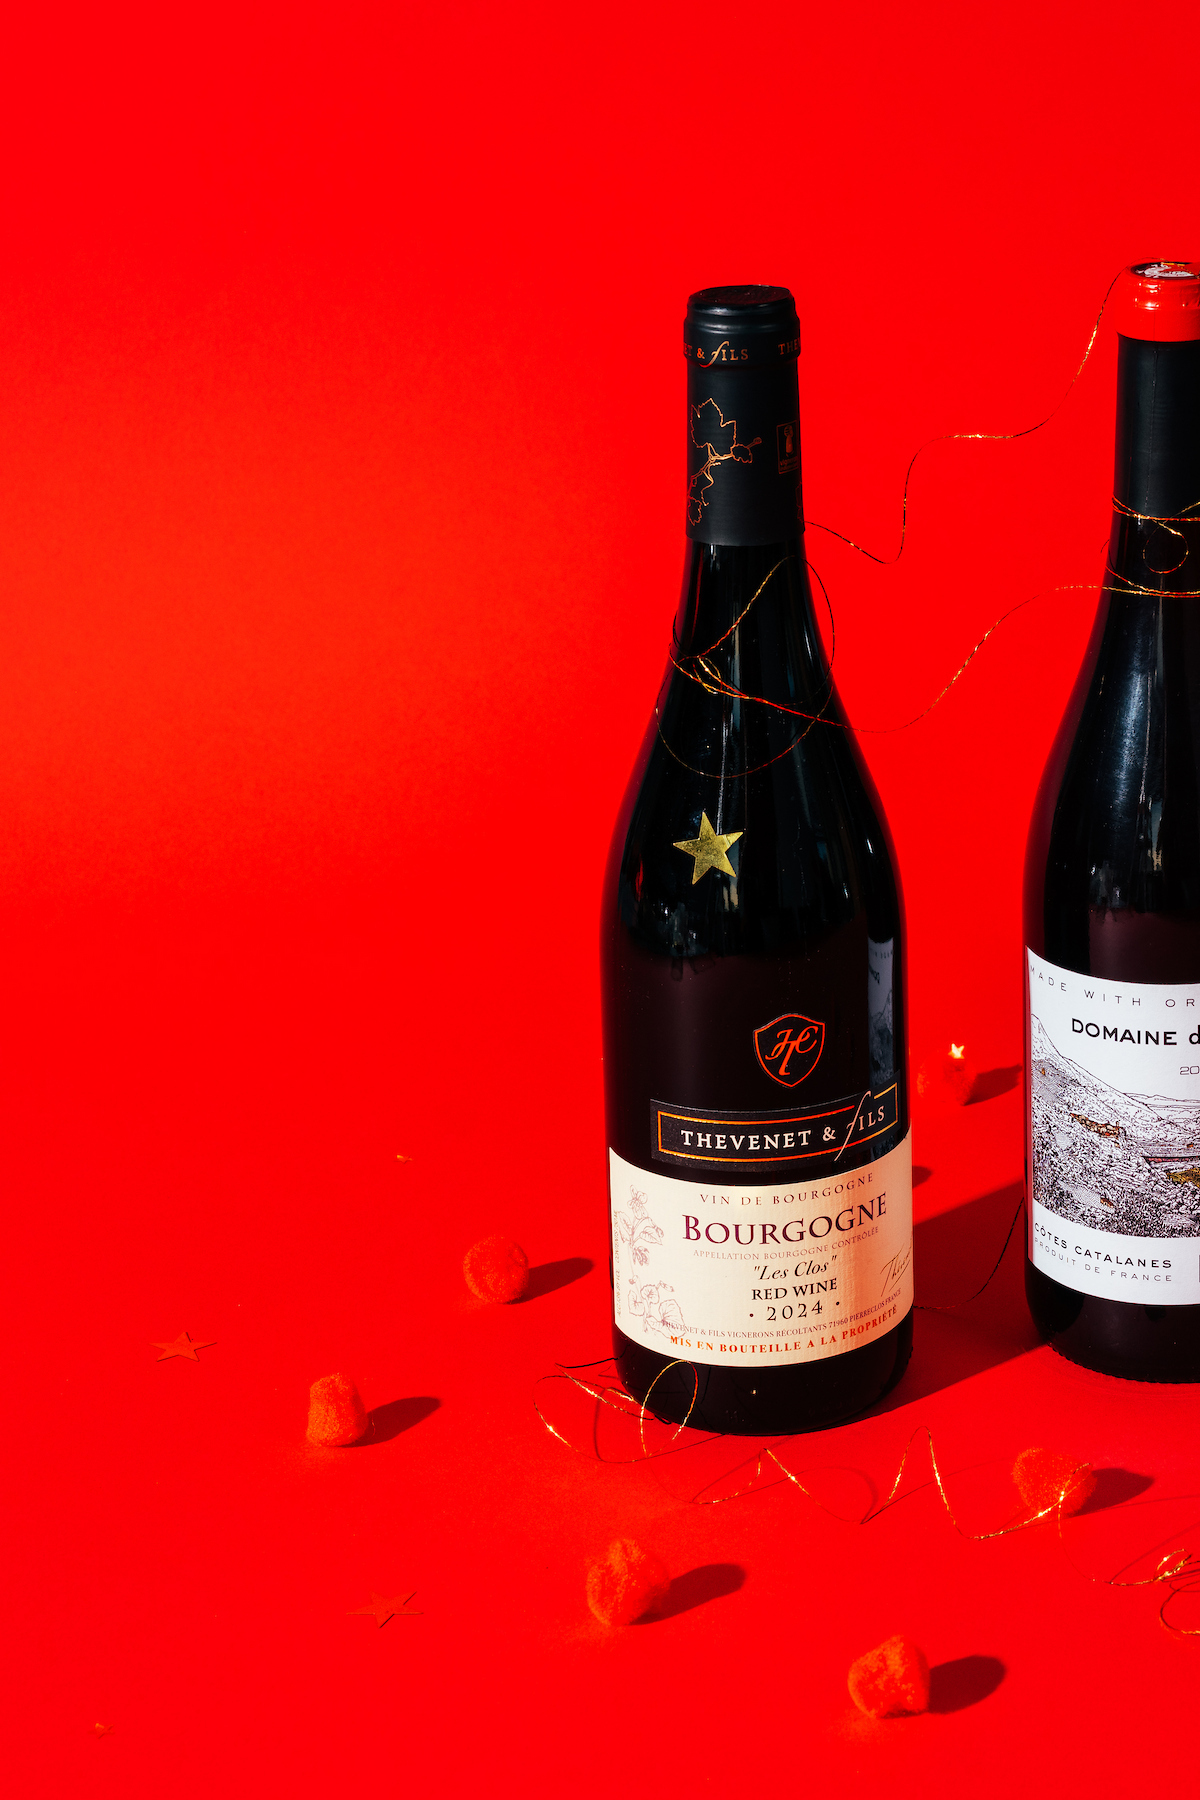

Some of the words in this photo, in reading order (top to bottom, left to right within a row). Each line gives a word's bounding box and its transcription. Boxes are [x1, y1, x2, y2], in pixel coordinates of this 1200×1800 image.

[696, 347, 706, 359] &
[1030, 965, 1067, 992] MADE
[1083, 989, 1141, 1006] WITH
[1072, 1017, 1178, 1046] DOMAINE
[680, 1129, 812, 1151] THEVENET
[822, 1126, 836, 1142] &
[700, 1193, 730, 1206] VIN
[740, 1196, 763, 1206] DE
[772, 1172, 874, 1205] BOURGOGNE
[682, 1192, 887, 1245] BOURGOGNE
[693, 1249, 760, 1261] APPELLATION
[764, 1244, 829, 1260] BOURGOGNE
[831, 1226, 879, 1250] CONTRÔLÉE
[1034, 1222, 1068, 1249] CÔTES
[1074, 1245, 1172, 1269] CATALANES
[1034, 1237, 1076, 1266] PRODUIT
[1084, 1263, 1101, 1274] DE
[1110, 1270, 1172, 1282] FRANCE
[754, 1265, 789, 1281] "Les
[794, 1255, 838, 1277] Clos"
[752, 1287, 788, 1301] RED
[793, 1278, 838, 1298] WINE
[708, 1329, 726, 1338] FILS
[727, 1330, 775, 1339] VIGNERONS
[776, 1322, 828, 1338] RÉCOLTANTS
[849, 1300, 885, 1323] PIERRECLOS
[884, 1288, 902, 1306] FRANCE
[766, 1300, 823, 1321] 2024
[670, 1335, 692, 1348] MIS
[697, 1340, 714, 1351] EN
[720, 1341, 802, 1354] BOUTEILLE
[806, 1339, 816, 1349] A
[820, 1335, 837, 1346] LA
[841, 1303, 898, 1340] PROPRIÉTÉ
